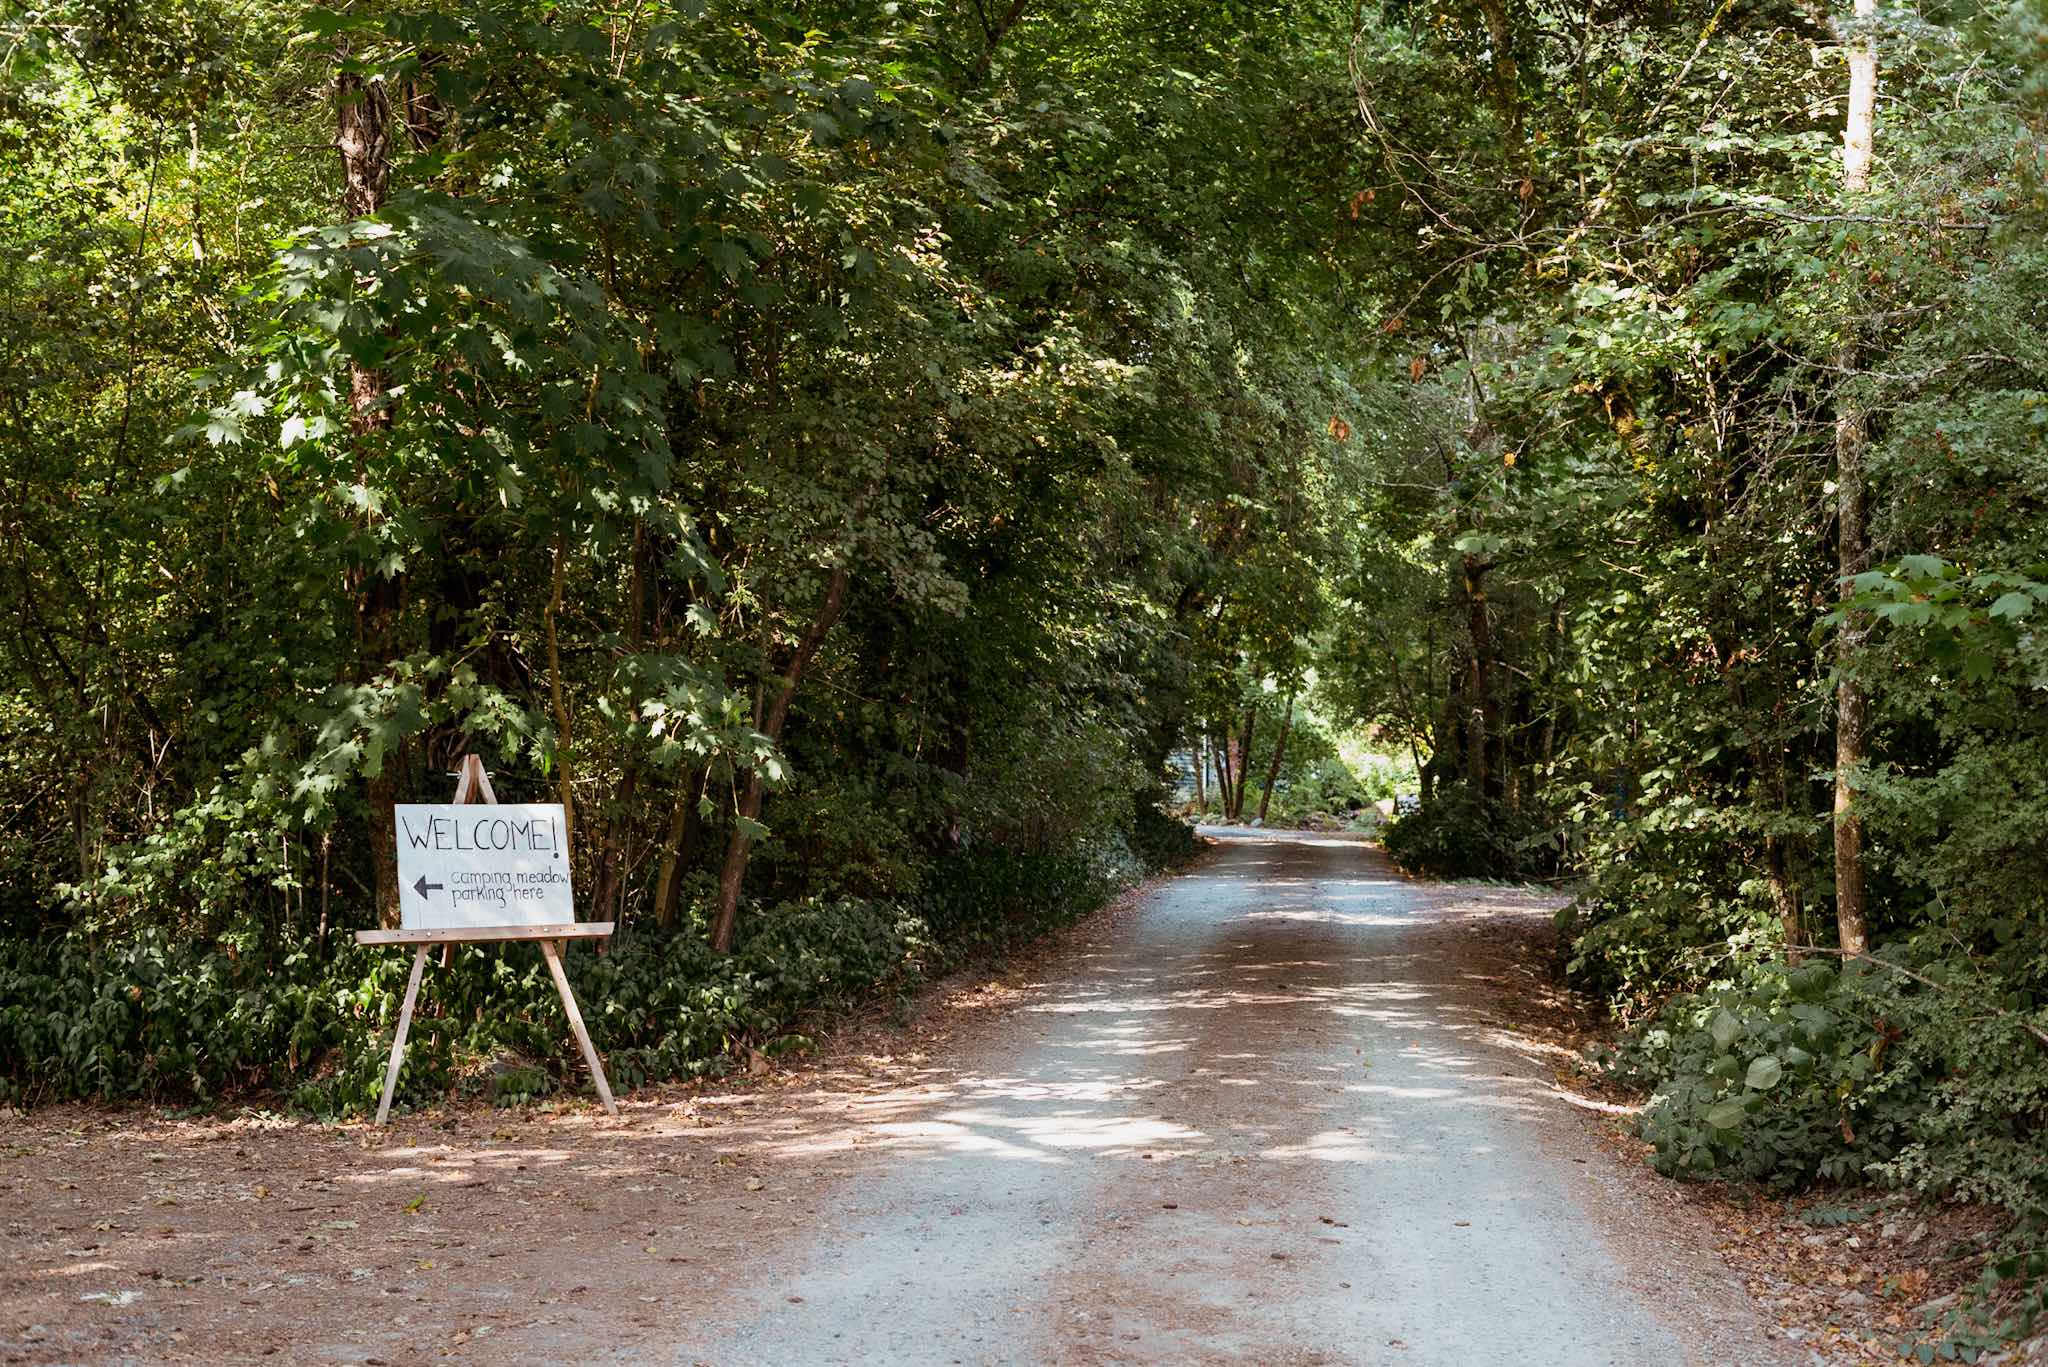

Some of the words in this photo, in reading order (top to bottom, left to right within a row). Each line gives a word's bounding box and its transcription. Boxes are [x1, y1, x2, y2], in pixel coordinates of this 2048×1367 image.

[402, 814, 559, 859] WELCOME!
[451, 871, 513, 892] camping
[516, 866, 568, 884] meadow
[452, 886, 507, 909] parking
[512, 885, 544, 900] here
